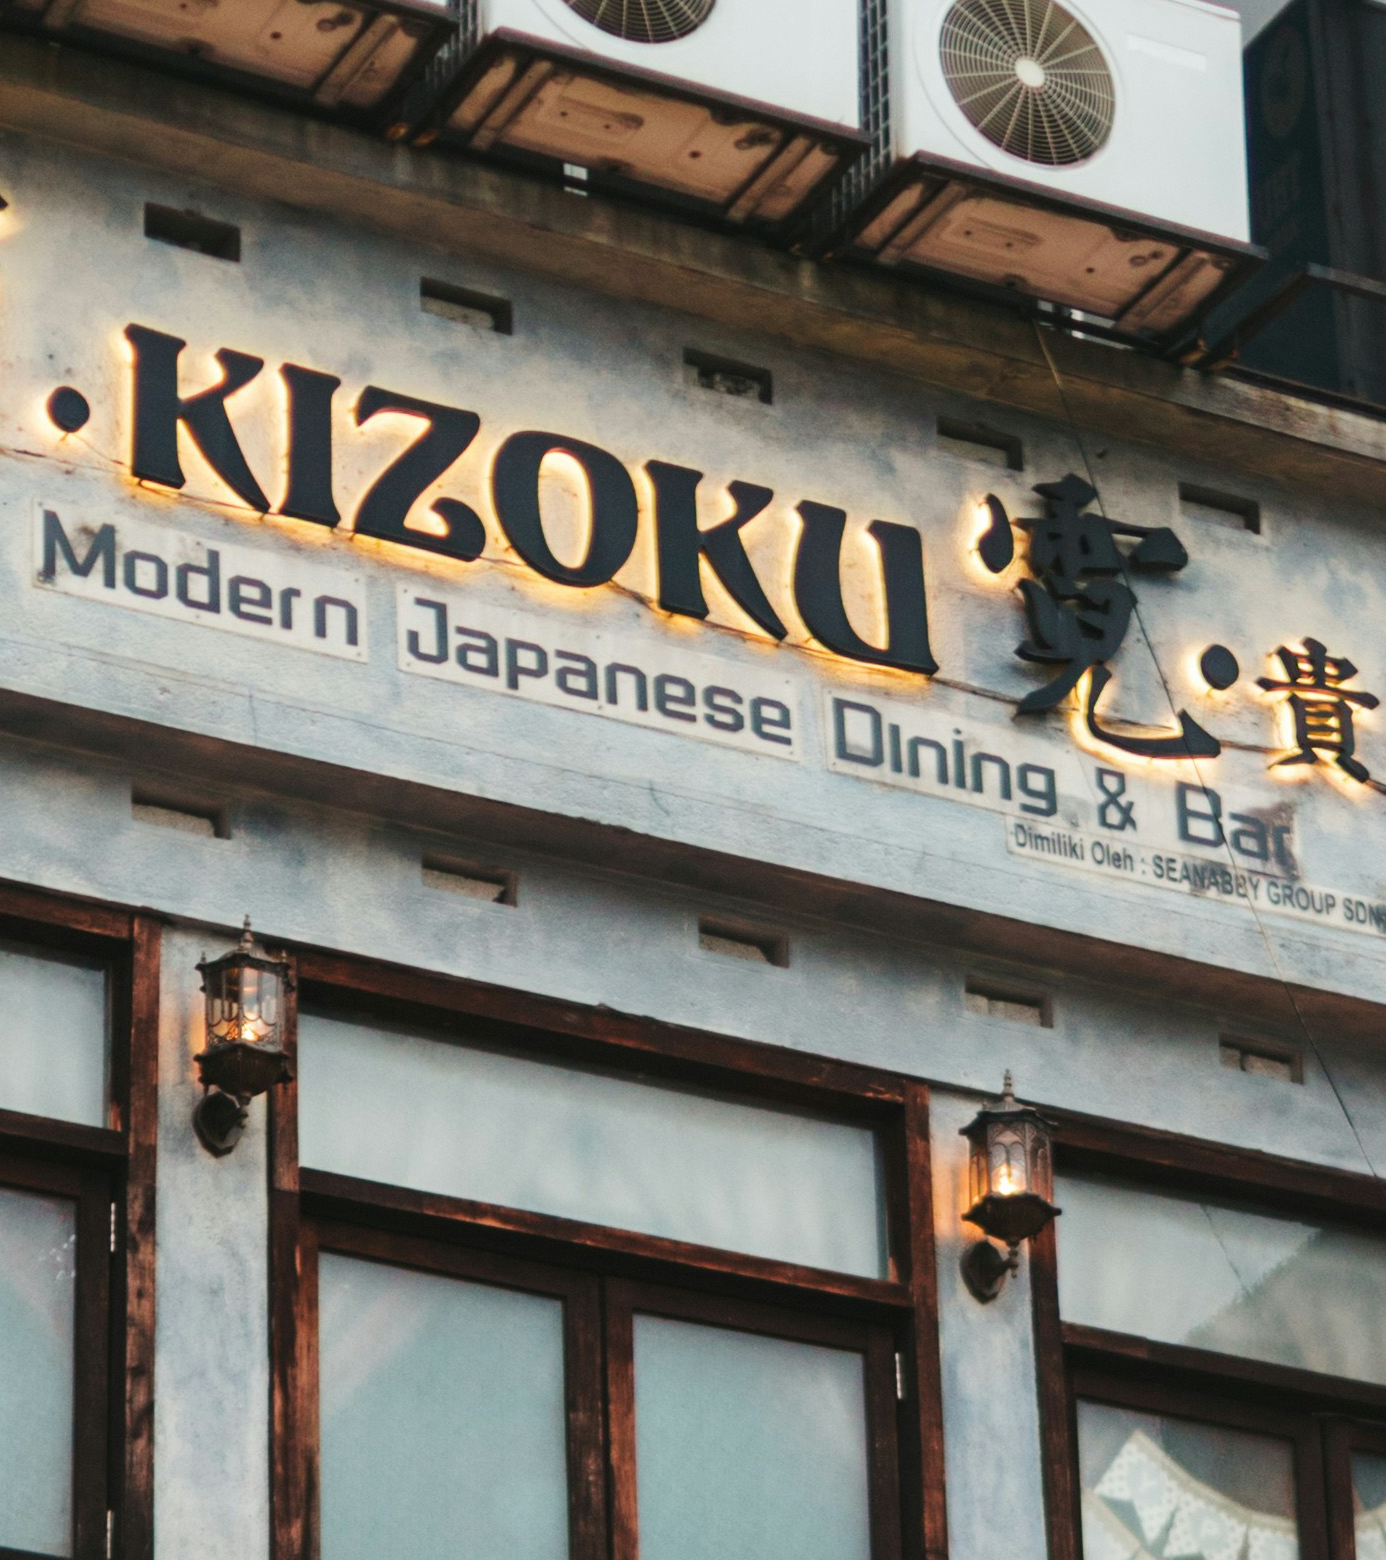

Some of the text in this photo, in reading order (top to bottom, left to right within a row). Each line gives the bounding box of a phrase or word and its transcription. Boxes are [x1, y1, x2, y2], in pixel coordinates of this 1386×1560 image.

[123, 321, 938, 676] KIZOKU
[43, 507, 1301, 880] Modern Japanese Dining & Bar
[1015, 824, 1086, 861] Dimiliki
[1091, 840, 1134, 871] Oleh
[1152, 854, 1261, 901] SEANABBY
[1266, 880, 1337, 916] GROUP
